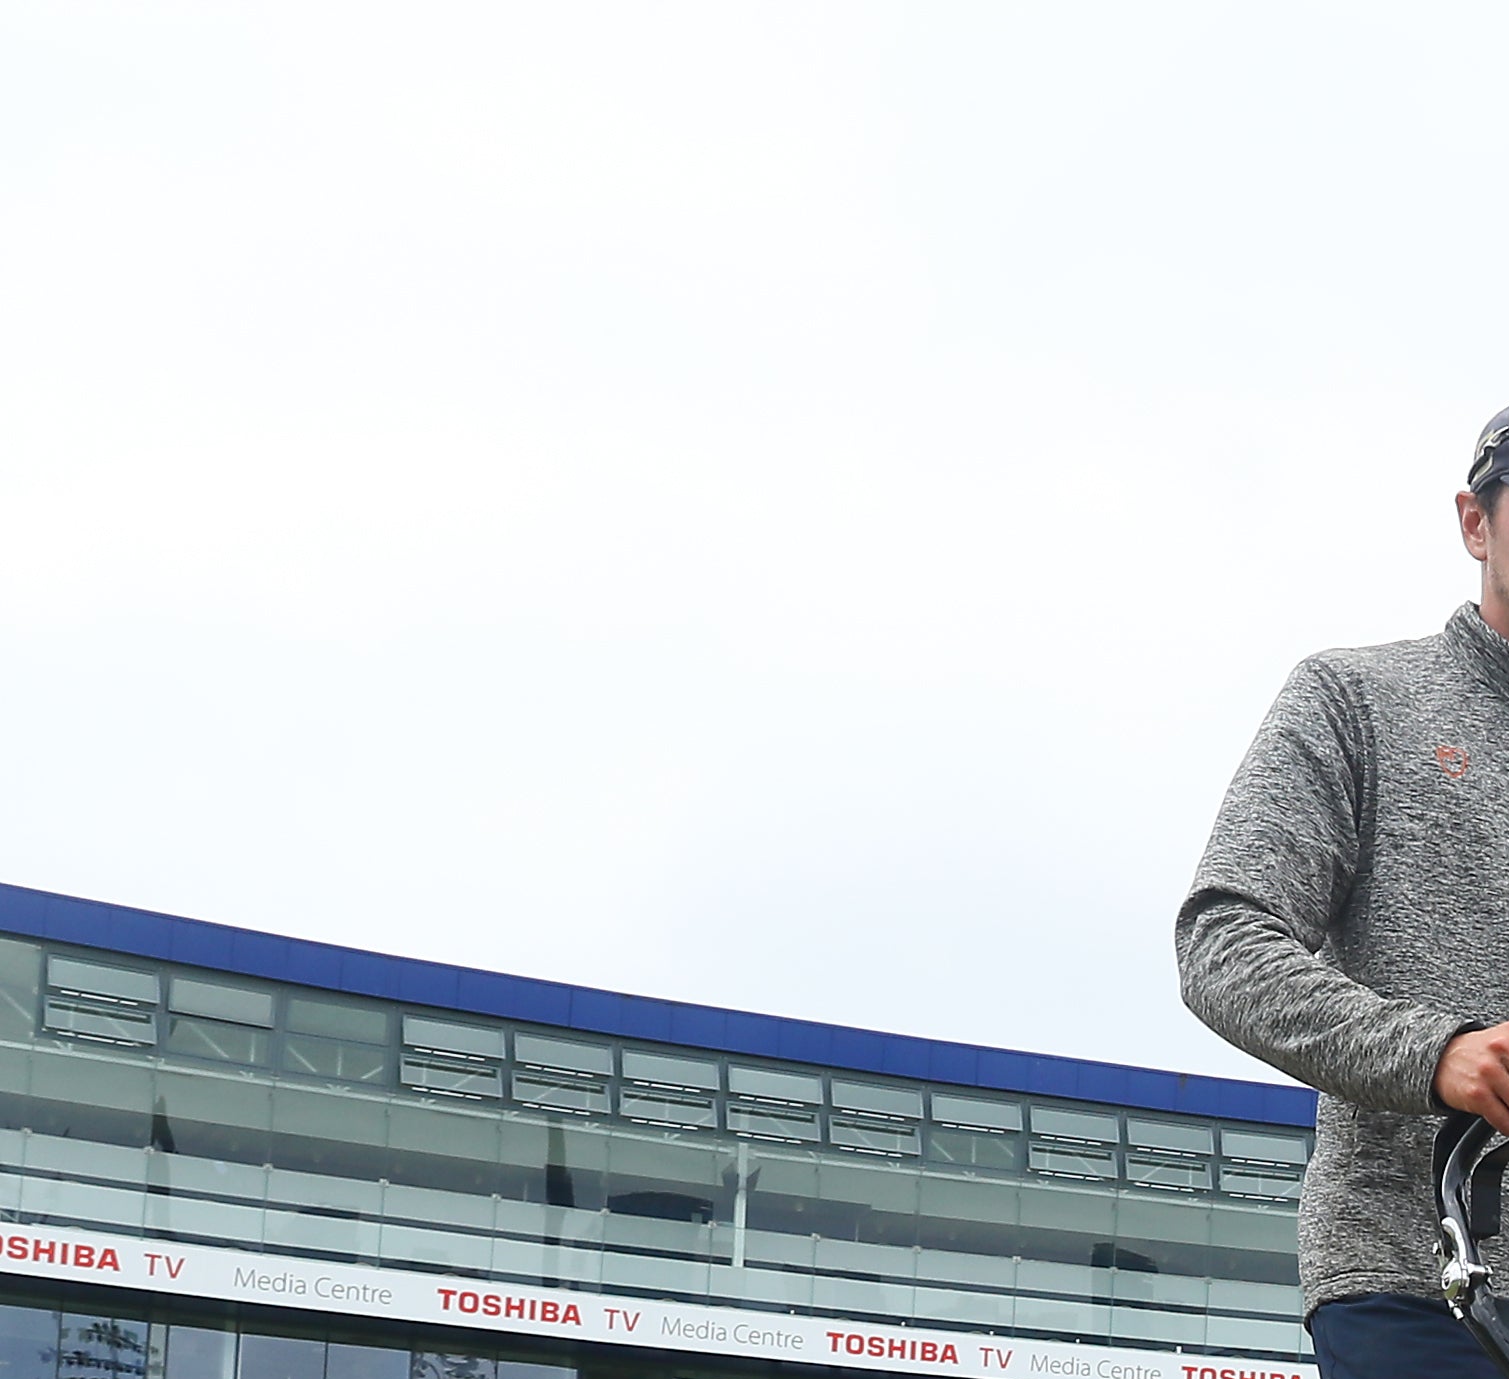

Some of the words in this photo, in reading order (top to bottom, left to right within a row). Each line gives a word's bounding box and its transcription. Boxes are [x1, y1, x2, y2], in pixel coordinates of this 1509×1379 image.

[0, 1235, 121, 1272] SHIBA
[144, 1252, 187, 1280] TV
[233, 1267, 308, 1296] Media
[314, 1275, 394, 1306] Centre
[437, 1288, 583, 1327] TOSHIBA
[604, 1307, 642, 1333] TV
[661, 1316, 728, 1342] Media
[733, 1323, 805, 1351] Centre
[826, 1331, 960, 1365] TOSHIBA
[979, 1347, 1014, 1369] TV
[1030, 1353, 1092, 1377] Media
